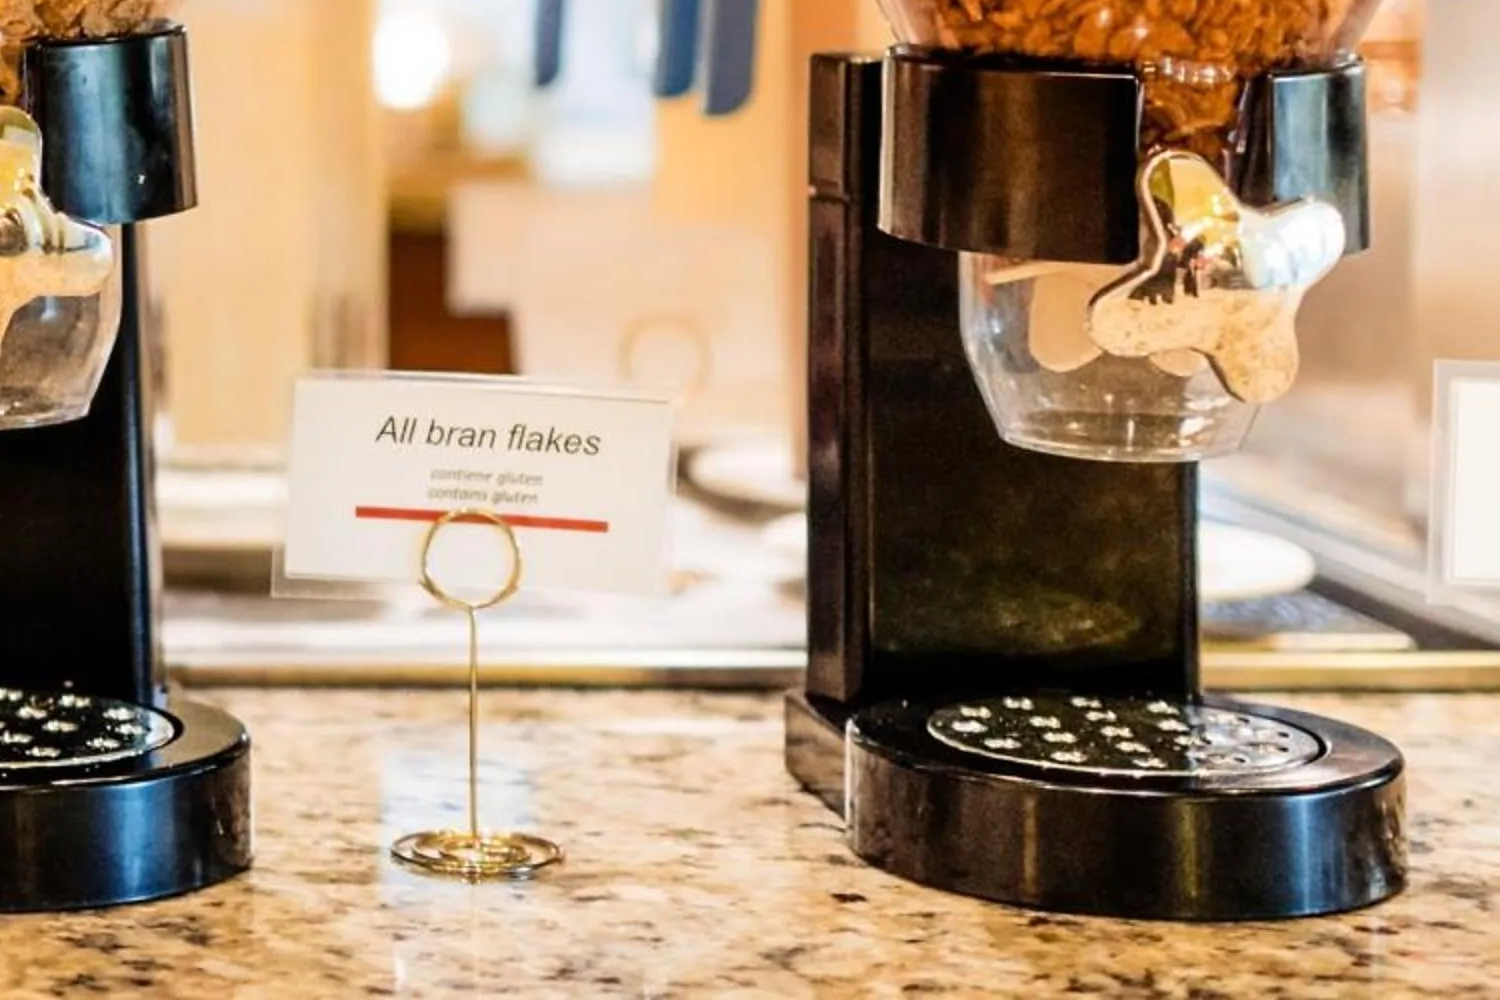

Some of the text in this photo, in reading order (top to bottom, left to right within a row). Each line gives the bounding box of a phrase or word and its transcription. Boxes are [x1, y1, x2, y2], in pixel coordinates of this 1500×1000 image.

[374, 414, 602, 457] All bran flakes
